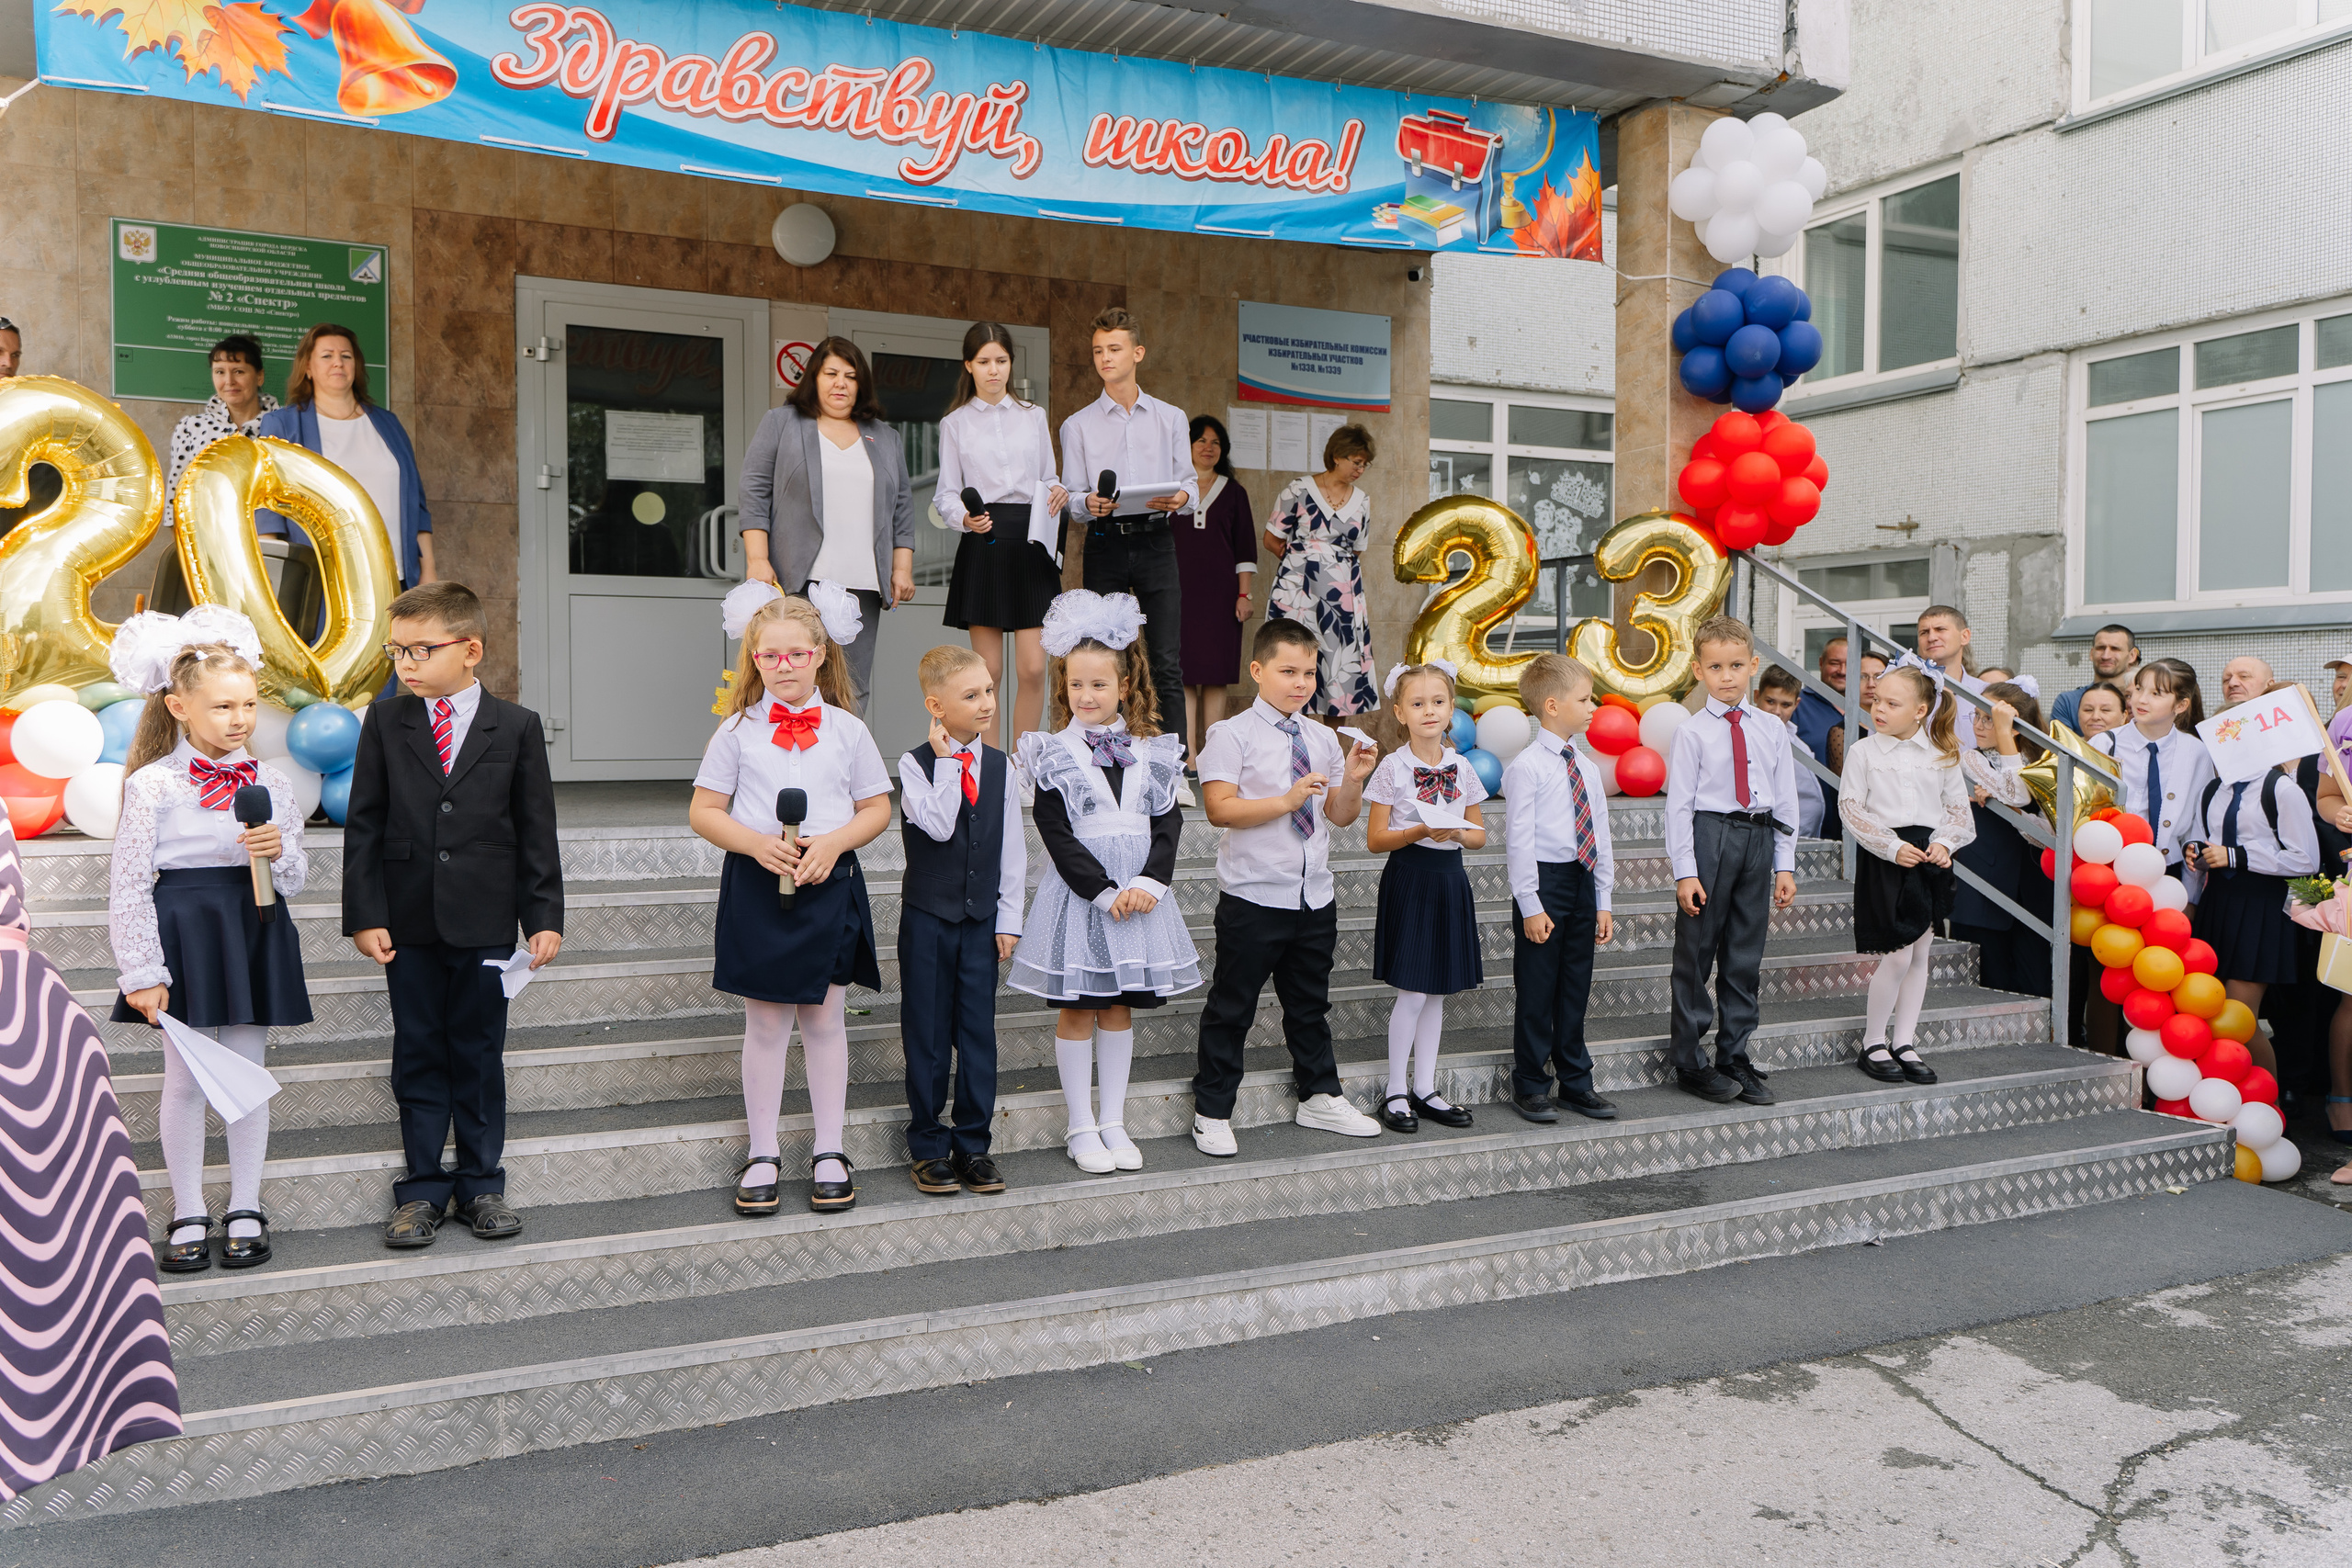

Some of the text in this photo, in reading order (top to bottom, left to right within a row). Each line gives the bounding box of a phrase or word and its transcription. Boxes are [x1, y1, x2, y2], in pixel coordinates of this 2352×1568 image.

[490, 2, 1365, 195] Здравствуй, школа!
[198, 236, 254, 246] АДМИНИСТРАЦИЯ
[209, 243, 266, 254] НОВОСИБИРСКОЙ
[181, 260, 323, 279] ОБЩЕОБРАЗОВАТЕЛЬНОЕ УЧРЕЖДЕНИЕ
[194, 254, 311, 270] МУНИЦИПАЛЬНОЕ БЮДЖЕТНОЕ
[158, 265, 345, 291] «Средняя общеобразовательная школа
[142, 276, 209, 288] углубленным
[211, 282, 263, 293] изучением
[265, 286, 315, 298] отдельных
[318, 292, 367, 302] предметов
[208, 291, 299, 310] № 2 «Спектр»
[167, 315, 190, 323] Режим
[233, 305, 253, 313] СОШ
[266, 310, 300, 318] «Спектр»)
[254, 332, 292, 340] воскресенье
[1242, 333, 1387, 355] УЧАСТКОВЫЕ ИЗБИРАТЕЛЬНЫЕ КОМИССИИ
[1268, 348, 1363, 365] ИЗБИРАТЕЛЬНЫХ УЧАСТКОВ
[1291, 363, 1341, 375] №1338, №1339
